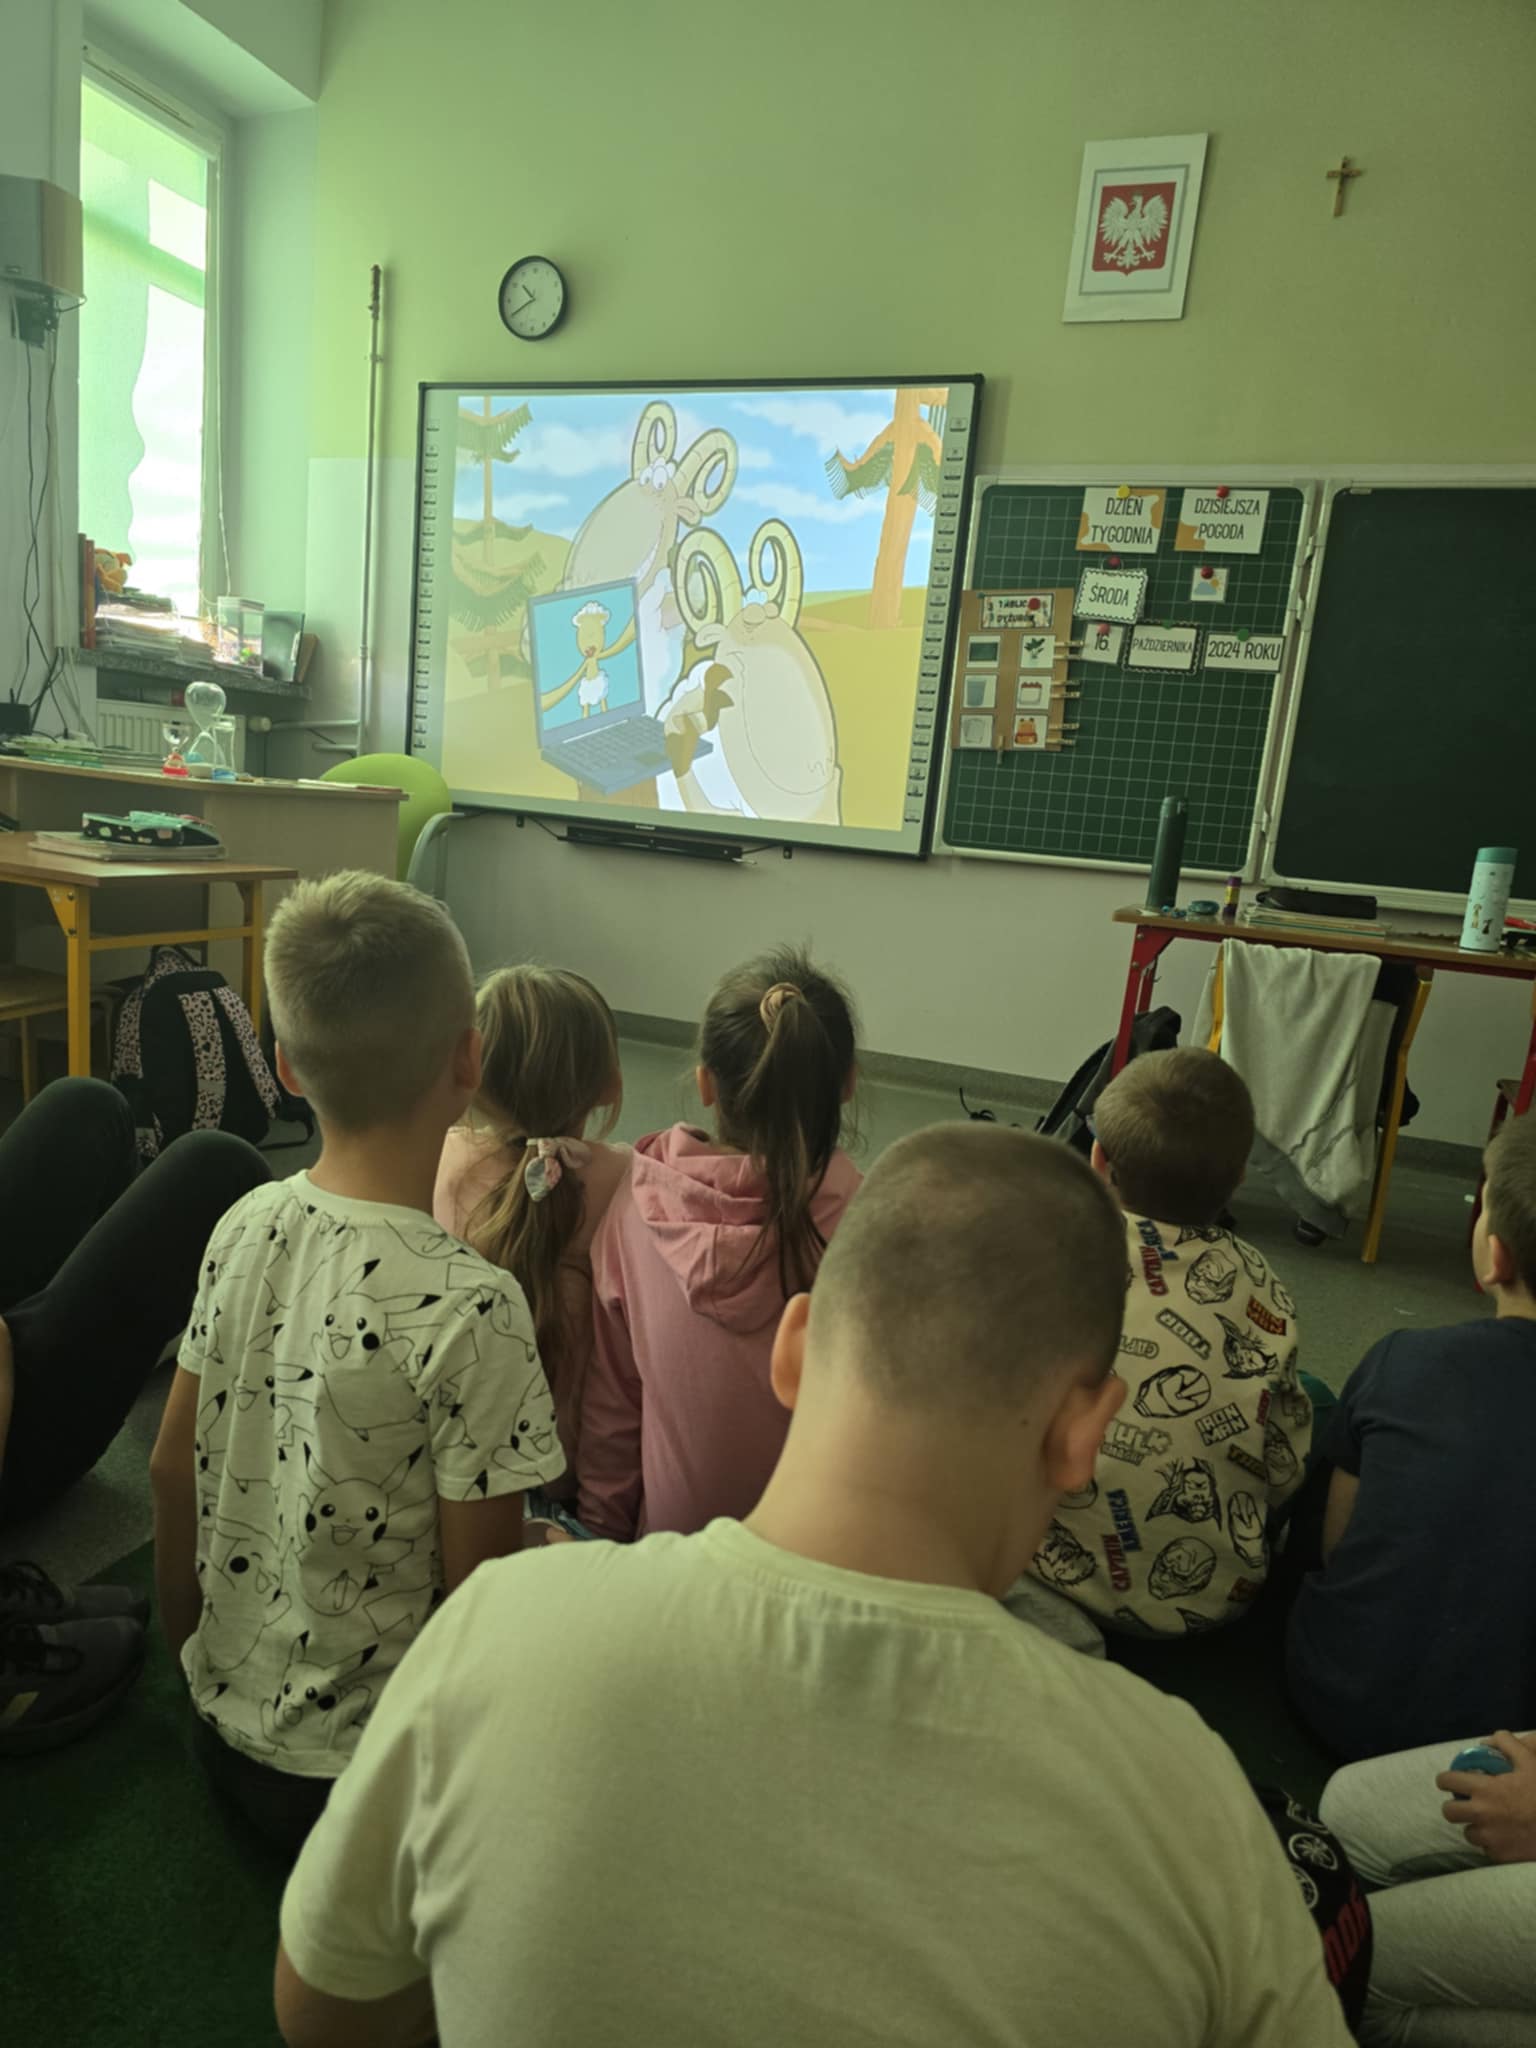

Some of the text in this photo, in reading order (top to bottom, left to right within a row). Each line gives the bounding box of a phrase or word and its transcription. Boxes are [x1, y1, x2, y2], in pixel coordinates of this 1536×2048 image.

[1105, 495, 1143, 516] DZIEŃ
[1194, 497, 1260, 516] DZISIEJSZA
[1091, 525, 1153, 545] TYGODNIA
[1198, 523, 1245, 540] POGODA
[1089, 582, 1130, 607] ŚRODA
[1208, 640, 1281, 661] 2024 ROKU
[1156, 1307, 1213, 1361] THOR
[1196, 1403, 1241, 1433] IRON
[1202, 1418, 1249, 1446] MAN
